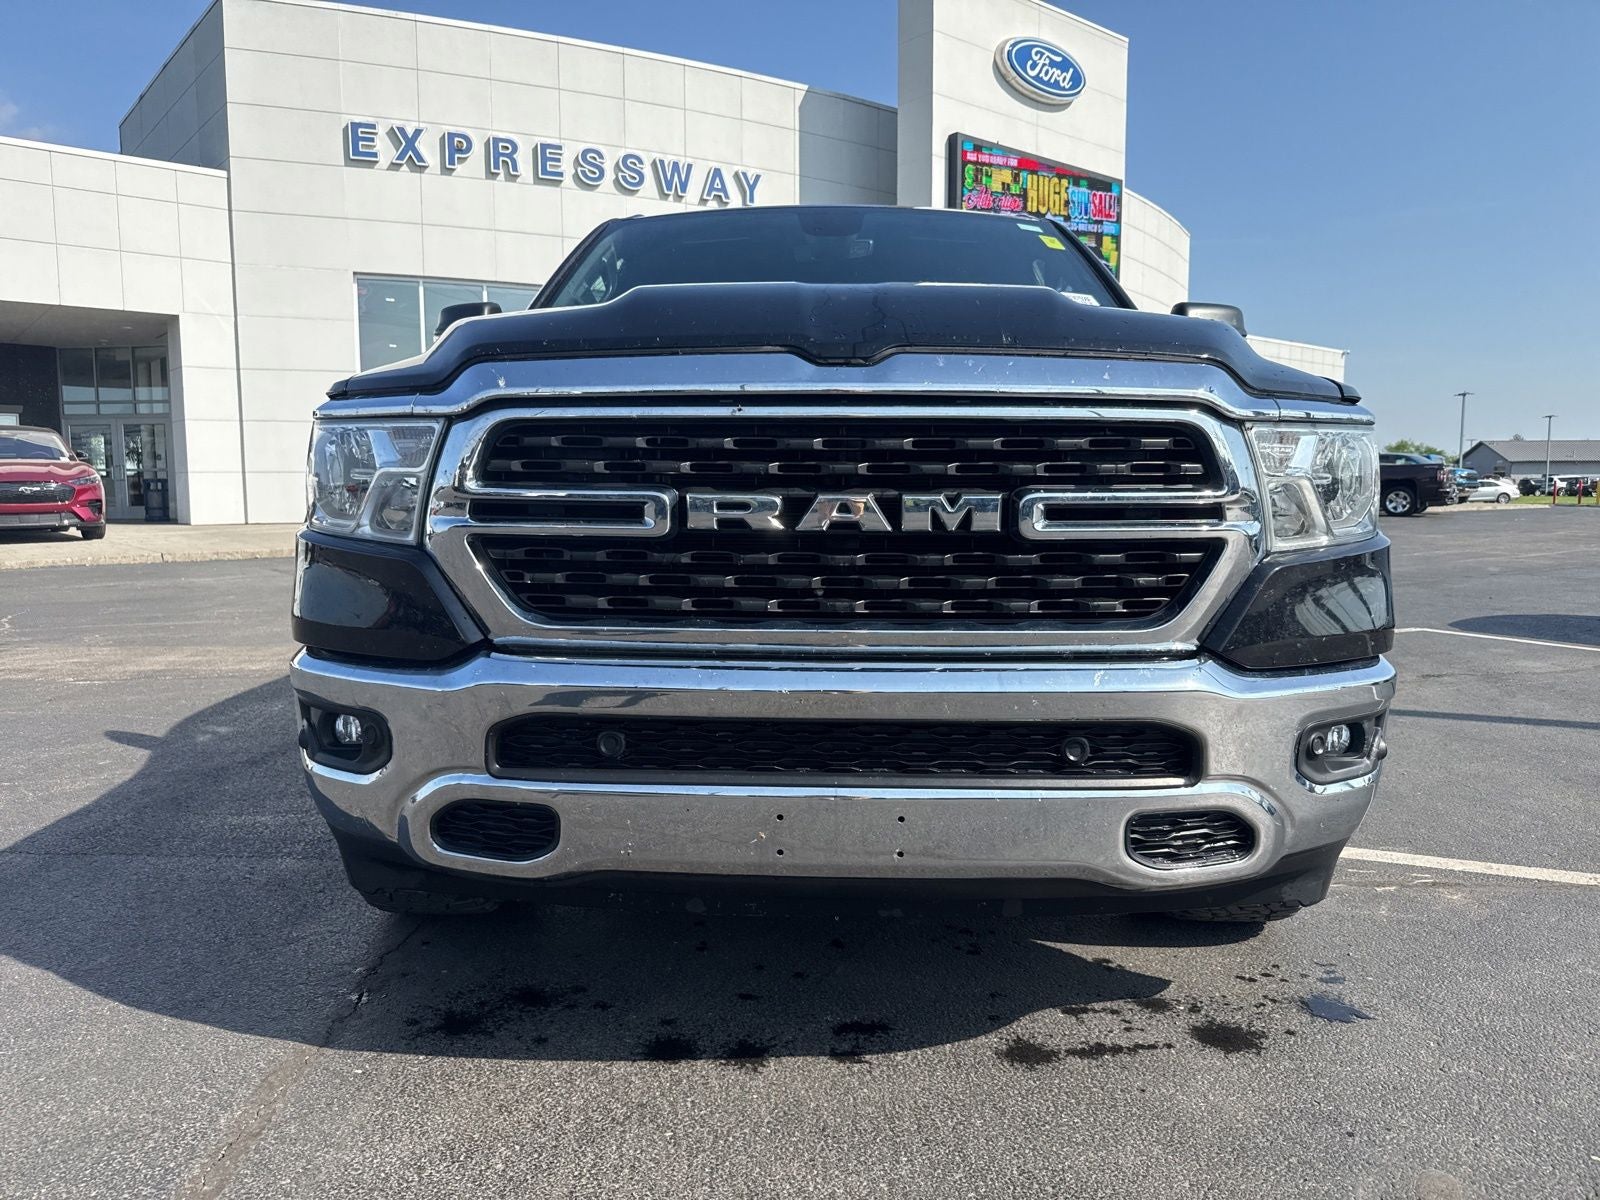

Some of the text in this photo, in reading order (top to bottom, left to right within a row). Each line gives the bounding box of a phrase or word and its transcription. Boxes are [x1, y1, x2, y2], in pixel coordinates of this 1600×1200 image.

[1026, 47, 1074, 89] Ford
[345, 120, 763, 206] EXPRESSWAY
[1026, 174, 1068, 216] HUGE
[686, 493, 1002, 532] RAM
